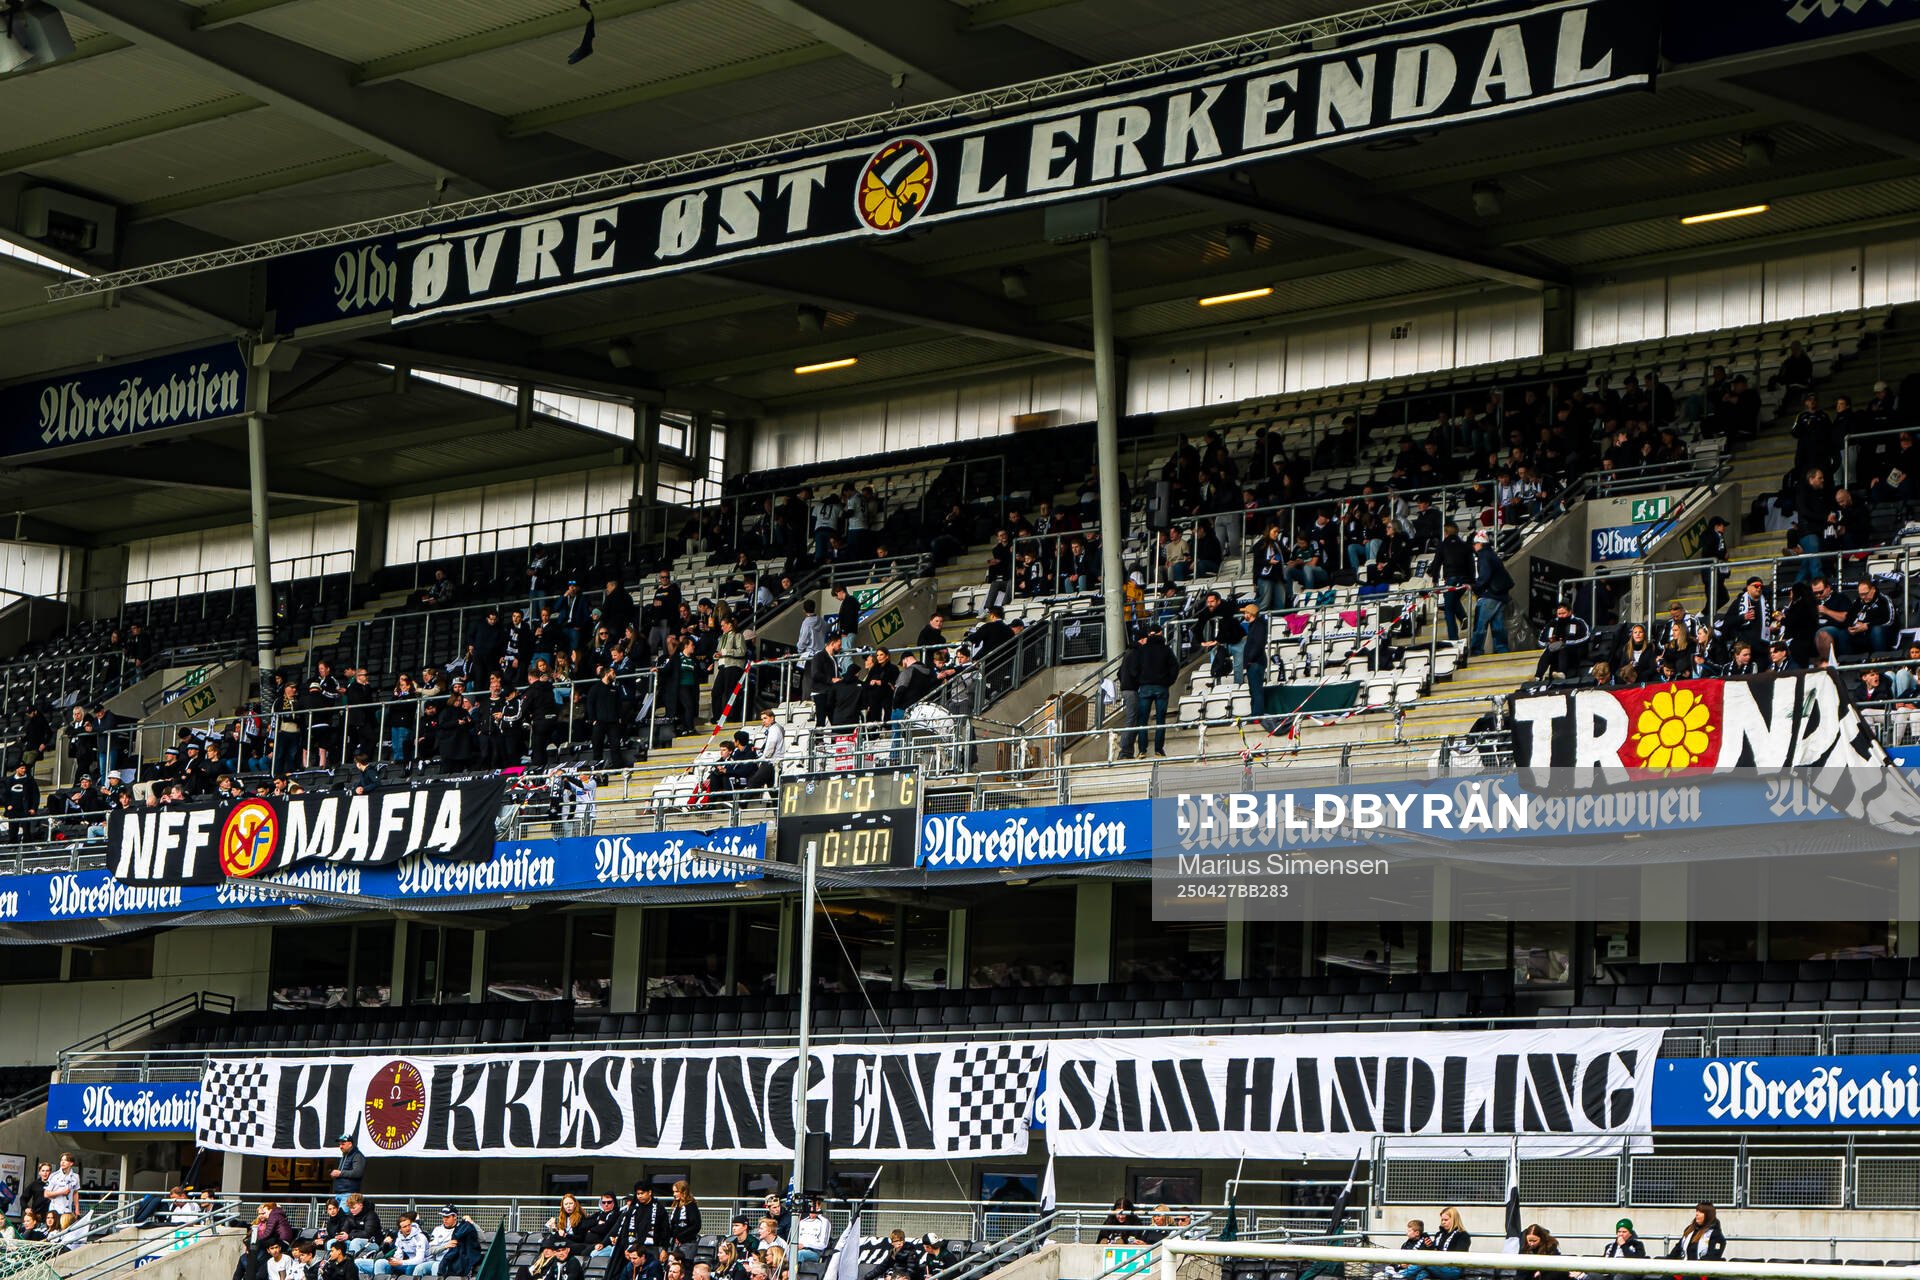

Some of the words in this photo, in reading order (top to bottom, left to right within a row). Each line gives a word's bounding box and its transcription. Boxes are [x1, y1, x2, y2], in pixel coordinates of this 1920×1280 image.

[409, 207, 619, 307] ØVRE
[654, 164, 826, 260] ØST
[956, 9, 1613, 206] LERKENDAL
[39, 364, 240, 444] Adresseavisen
[900, 778, 914, 805] G
[115, 808, 216, 880] NFF
[278, 789, 462, 868] MAFIA
[924, 812, 1127, 869] Adresseavisen
[82, 1085, 200, 1133] Adresseavis
[1059, 1050, 1638, 1132] SAMHANDLING
[1703, 1061, 1920, 1123] Adresseavi
